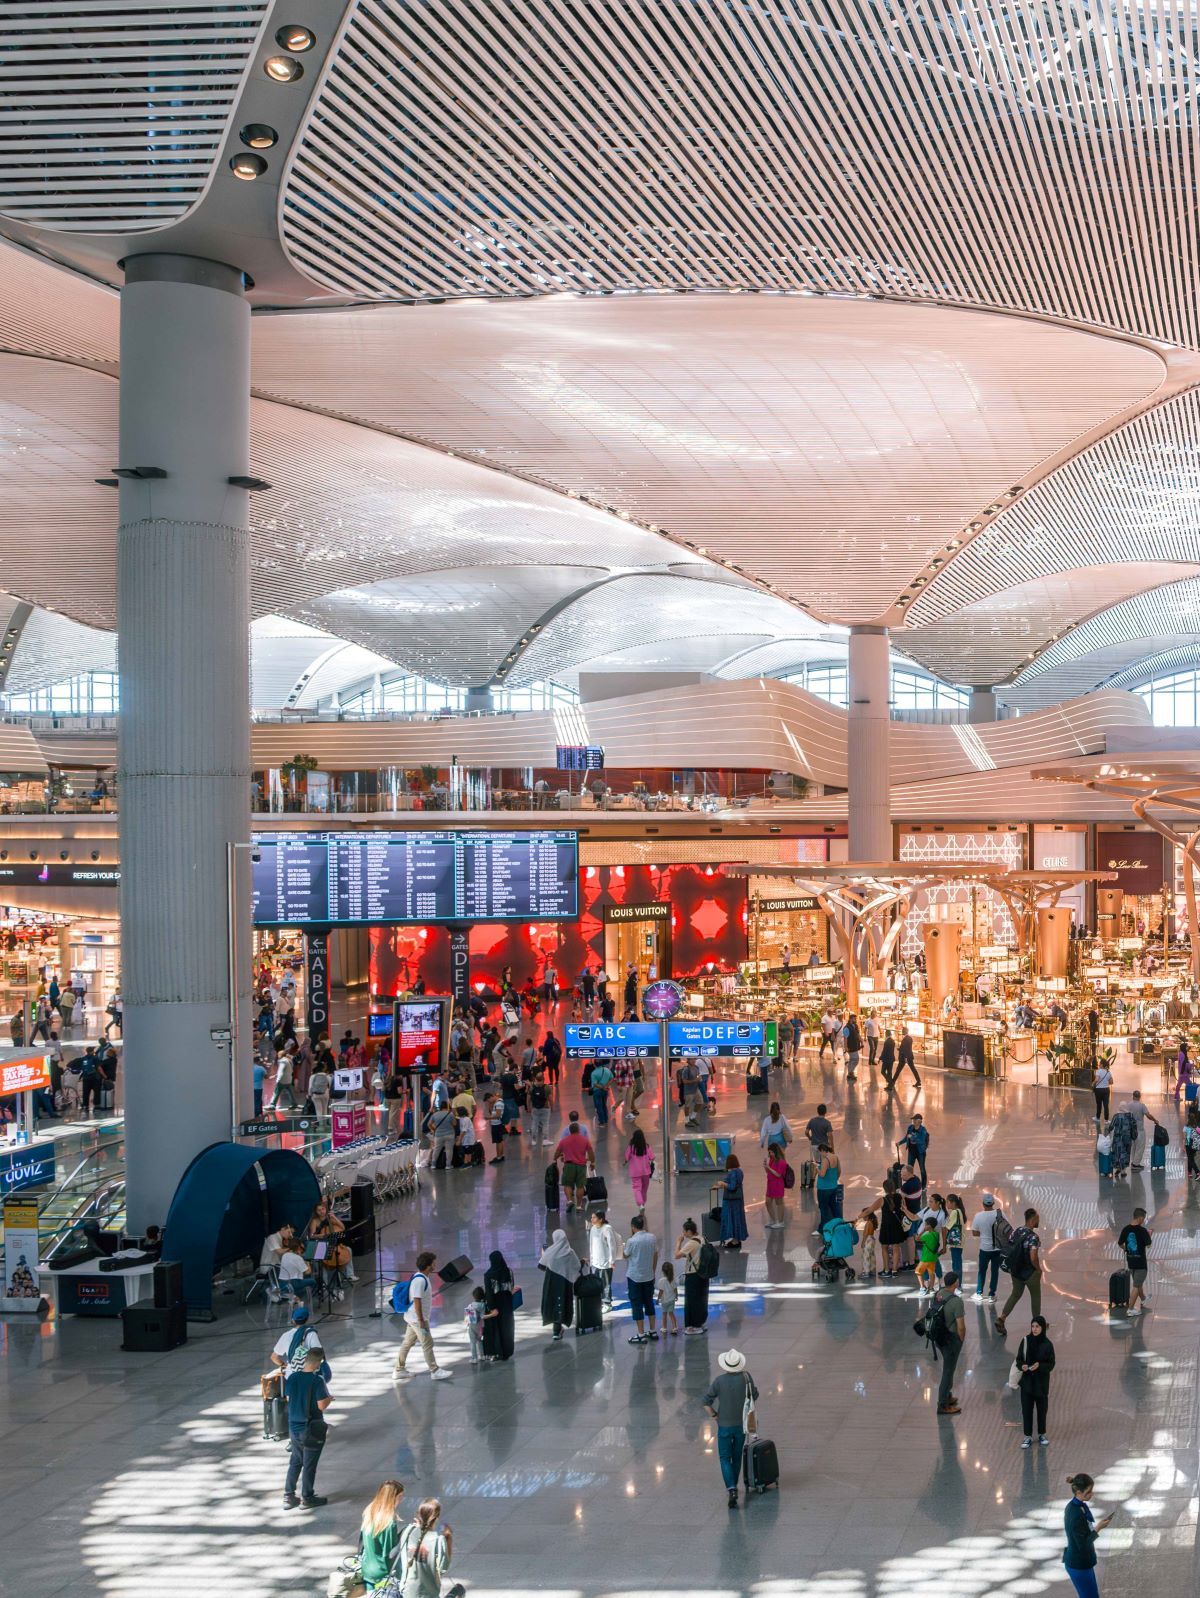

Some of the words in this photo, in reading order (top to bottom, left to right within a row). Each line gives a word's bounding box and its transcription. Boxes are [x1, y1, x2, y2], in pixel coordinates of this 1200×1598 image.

[610, 908, 633, 917] LOUIS
[635, 906, 667, 916] VUITTON
[767, 901, 785, 910] LOUIS
[787, 900, 813, 908] VUITTON
[312, 957, 324, 970] A
[455, 952, 467, 965] D
[312, 974, 322, 988] B
[456, 969, 464, 982] E
[312, 991, 323, 1005] C
[456, 986, 463, 999] F
[313, 1010, 325, 1023] D
[594, 1027, 602, 1038] A
[606, 1027, 614, 1038] B
[617, 1027, 626, 1039] C
[703, 1027, 712, 1038] D
[717, 1027, 723, 1038] E
[728, 1027, 734, 1038] F
[18, 1067, 34, 1077] FREE
[6, 1159, 42, 1183] döviz
